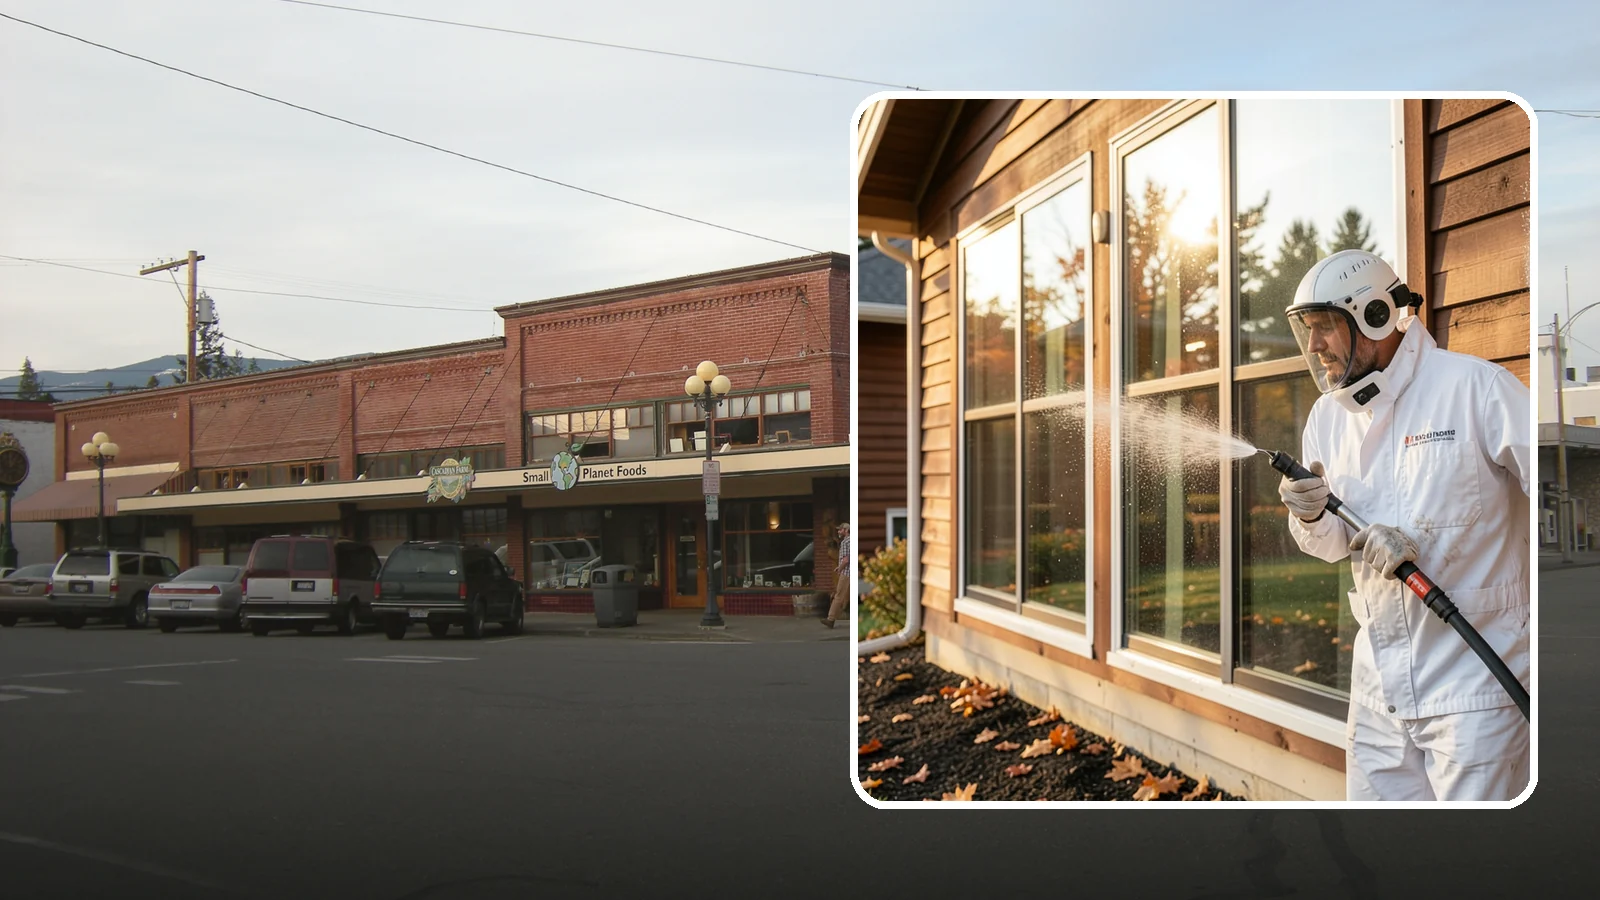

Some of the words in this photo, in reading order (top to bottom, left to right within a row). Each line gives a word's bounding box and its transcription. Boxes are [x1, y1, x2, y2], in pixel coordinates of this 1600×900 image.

[522, 471, 549, 483] Small
[582, 467, 614, 479] Planet
[617, 464, 647, 477] Foods
